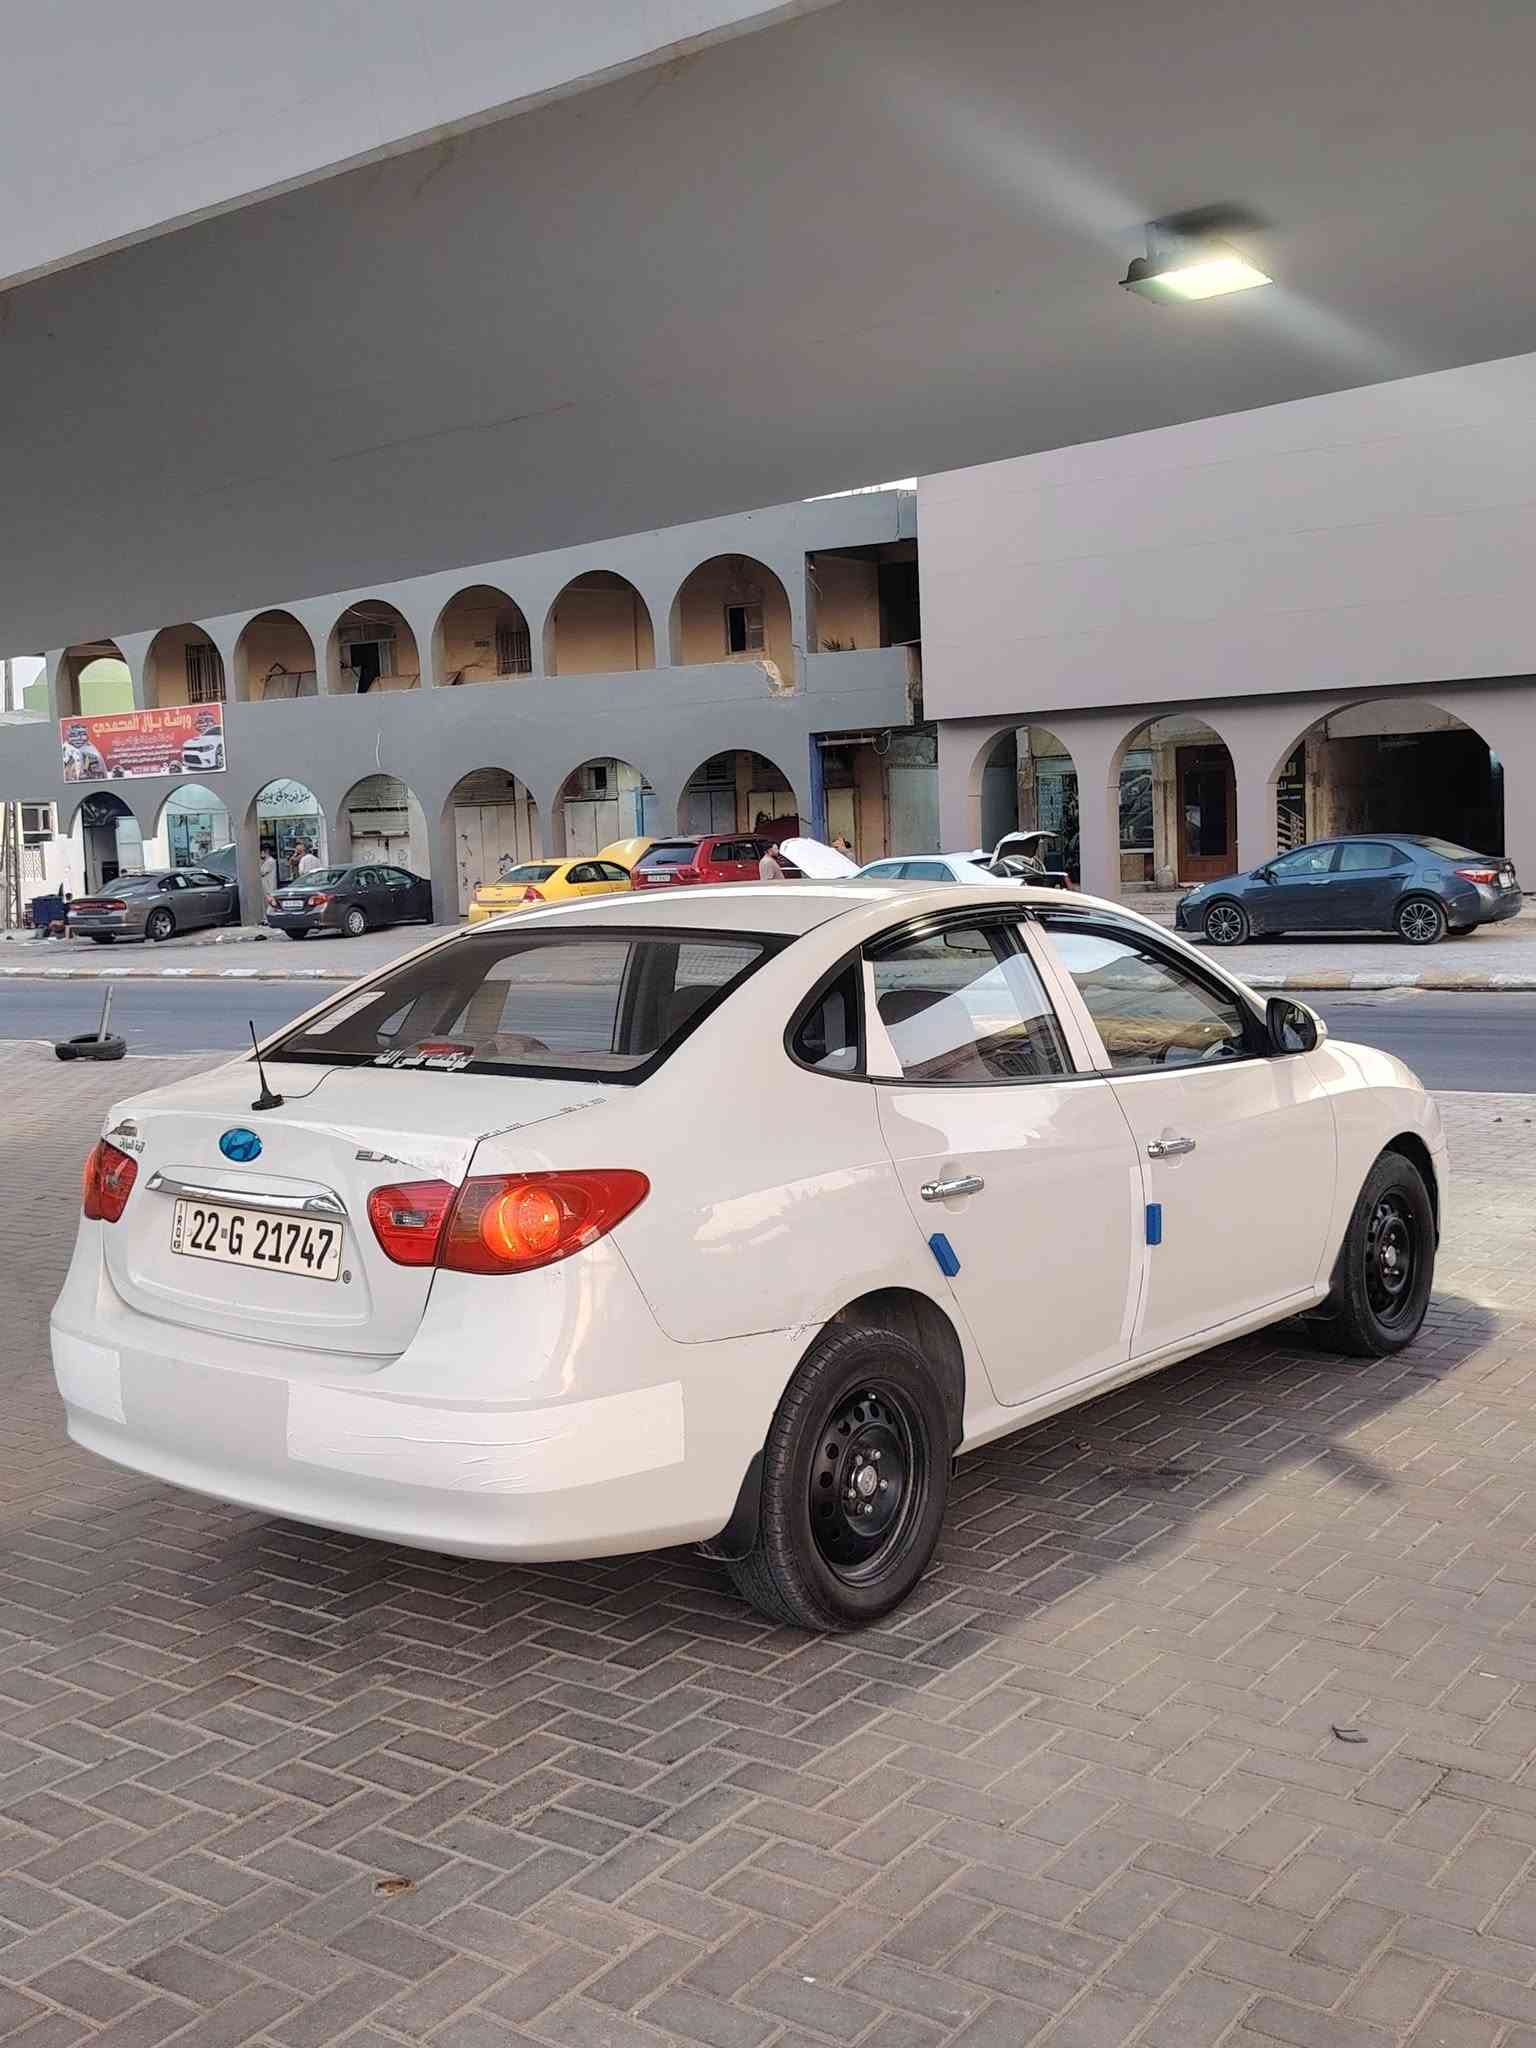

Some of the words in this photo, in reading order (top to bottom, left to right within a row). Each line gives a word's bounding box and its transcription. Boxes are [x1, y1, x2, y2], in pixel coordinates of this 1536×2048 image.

[92, 713, 140, 738] المحمدي
[141, 711, 162, 733] بلال
[163, 708, 192, 730] ورشة
[190, 1209, 220, 1252] 22
[228, 1215, 246, 1256] G
[252, 1219, 334, 1270] 21747
